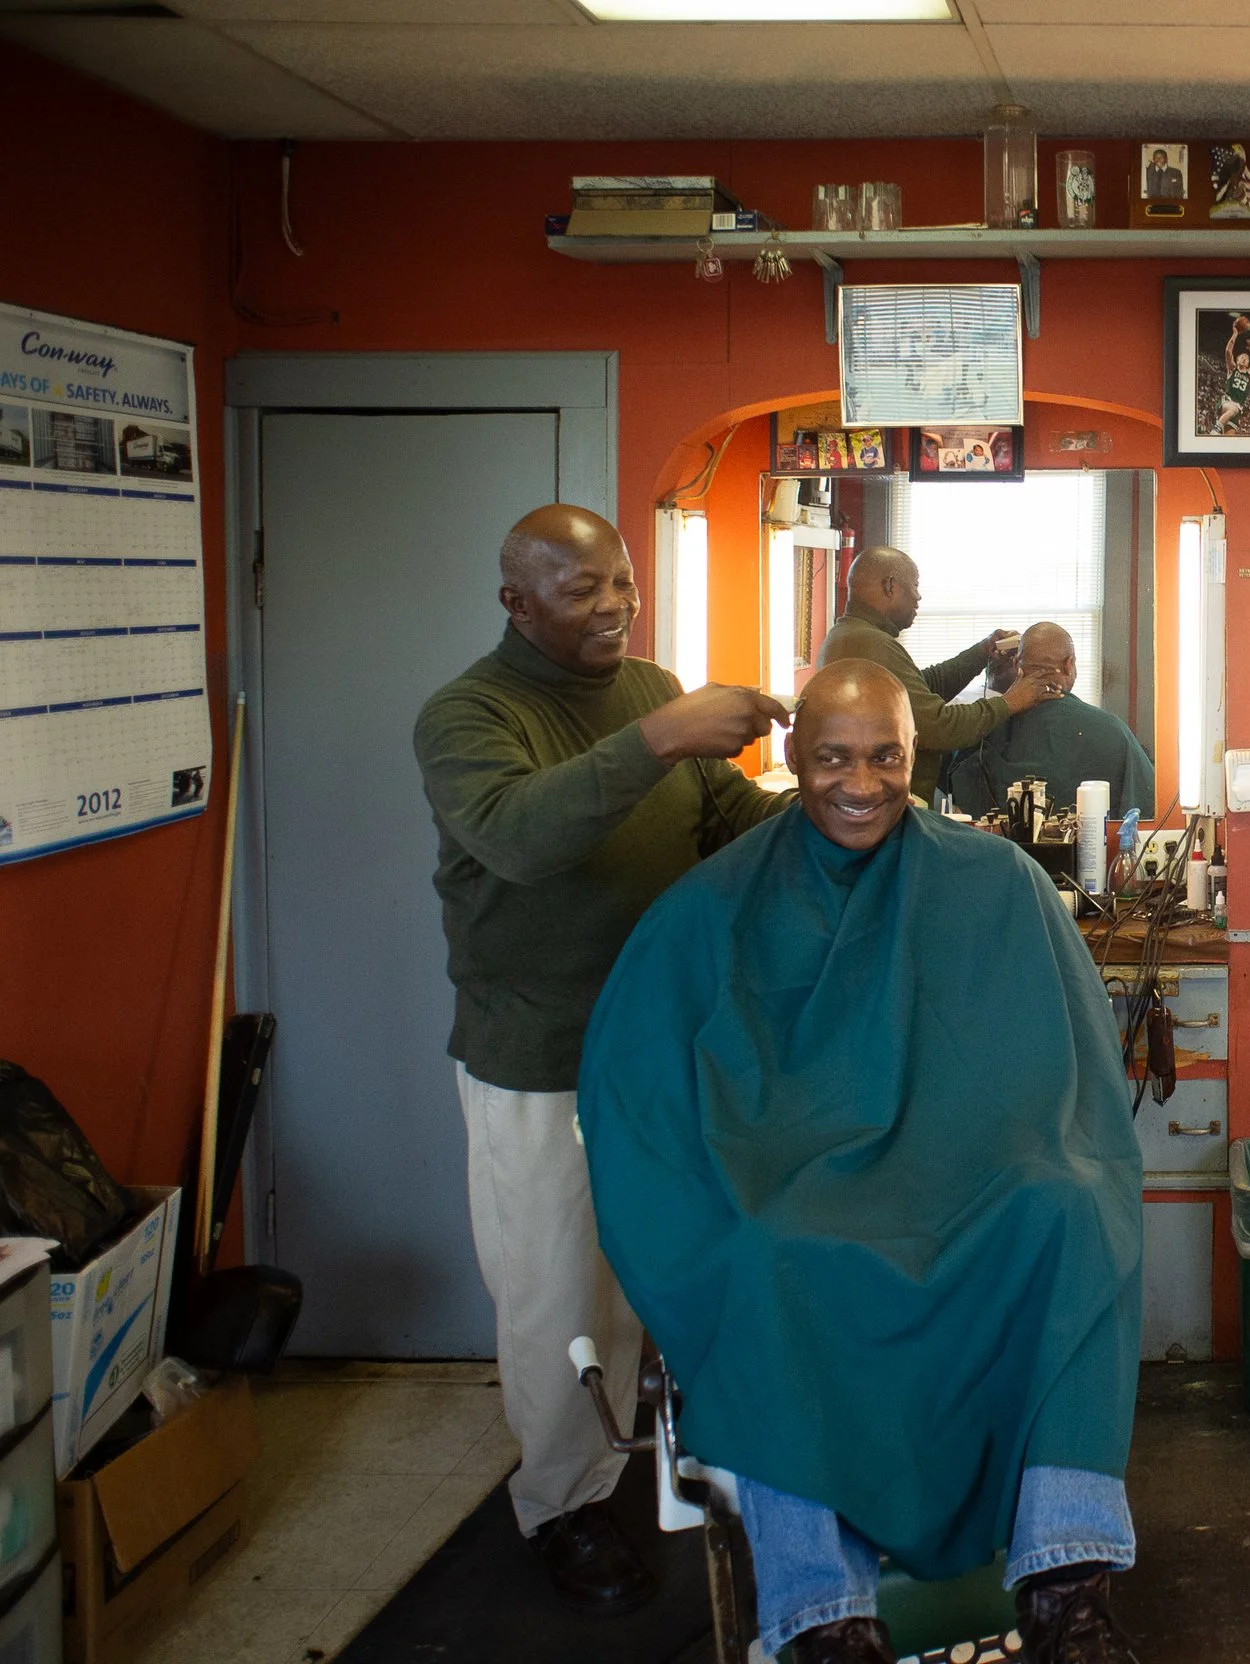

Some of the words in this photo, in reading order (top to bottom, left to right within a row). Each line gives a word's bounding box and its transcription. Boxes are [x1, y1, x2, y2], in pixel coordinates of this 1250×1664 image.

[30, 376, 49, 395] OF
[66, 384, 119, 406] SAFETY.
[122, 393, 173, 414] ALWAYS.
[1232, 378, 1247, 392] 33
[77, 788, 121, 817] 2012
